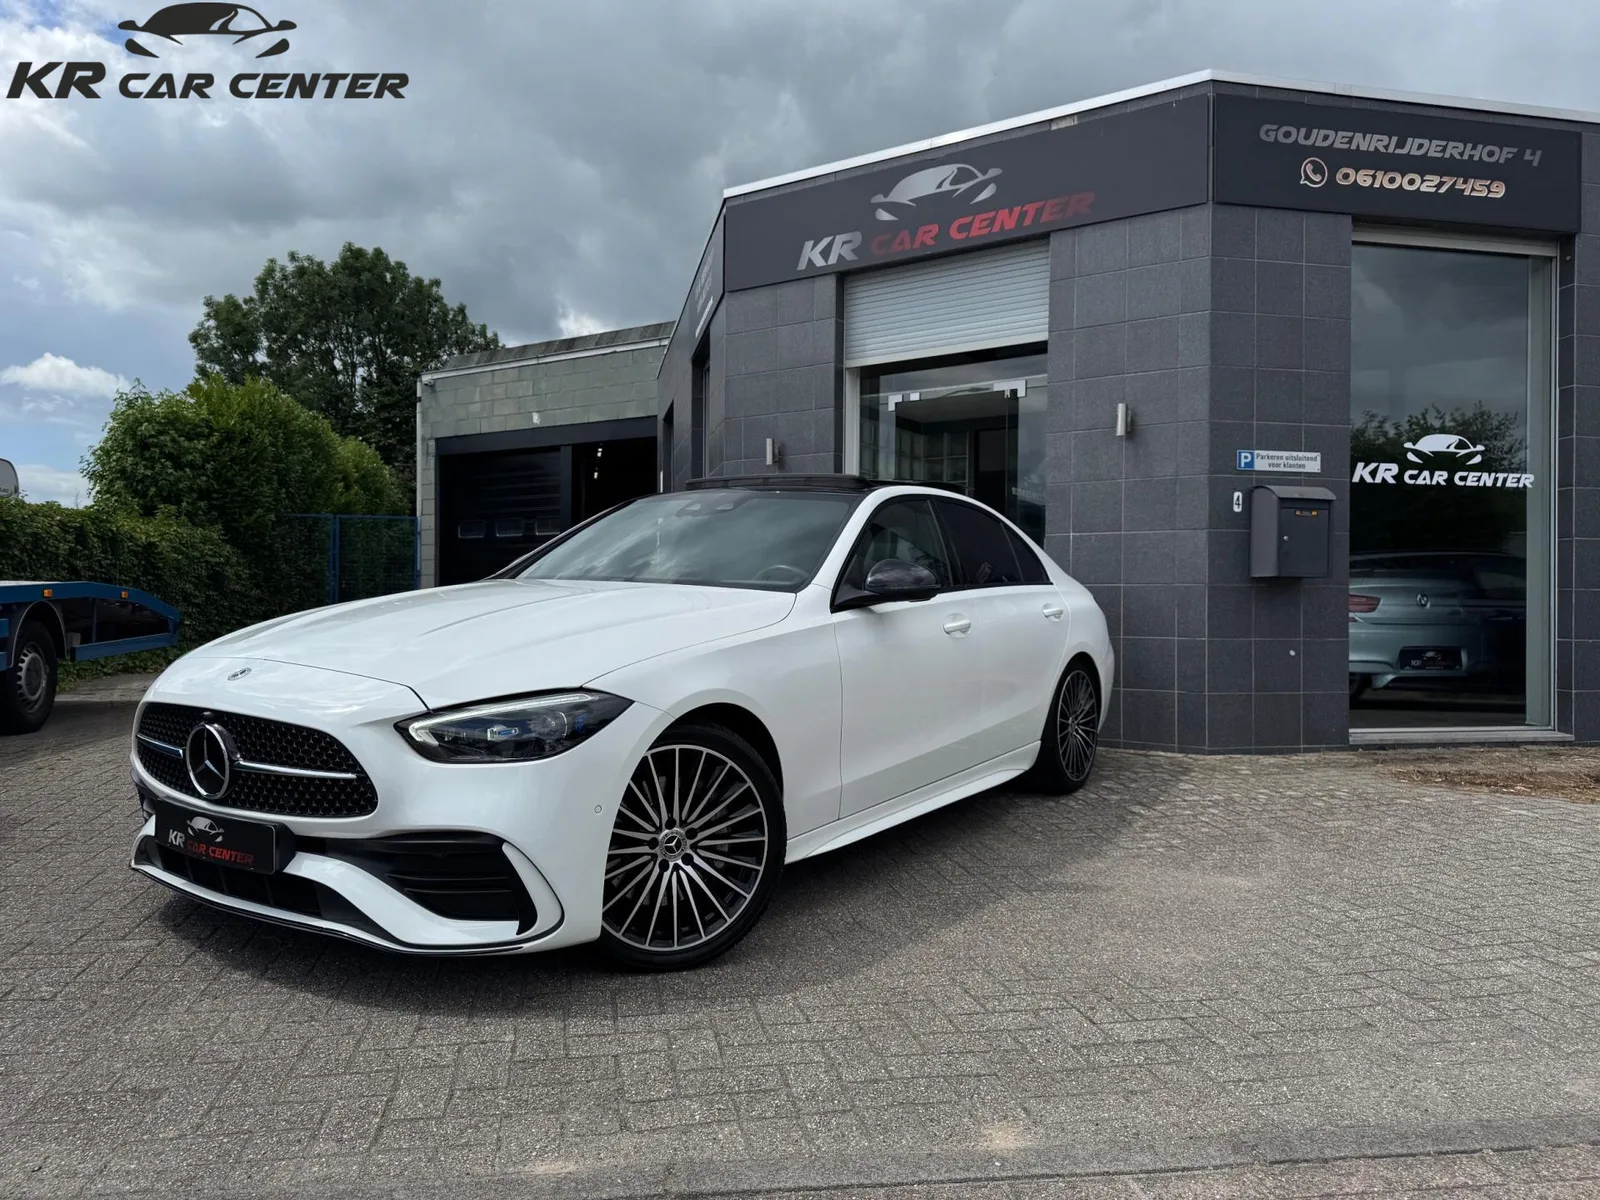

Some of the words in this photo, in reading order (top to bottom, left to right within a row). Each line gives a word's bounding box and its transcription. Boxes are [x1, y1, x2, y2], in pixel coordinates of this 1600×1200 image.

[1259, 123, 1518, 164] GOUDENRIJDERHOF
[1523, 149, 1543, 167] 4
[1335, 167, 1506, 198] 0610027459
[796, 231, 863, 271] KR
[870, 223, 939, 255] CAR
[949, 191, 1095, 240] CENTER
[1240, 452, 1252, 468] P
[1255, 452, 1284, 461] Parkeren
[1284, 453, 1318, 462] uitsluitend
[1283, 461, 1306, 469] klanten
[1351, 462, 1399, 484] KR
[1403, 469, 1448, 486] CAR
[1453, 471, 1535, 488] CENTER
[1234, 494, 1241, 509] 4
[168, 829, 185, 848] KR
[187, 840, 207, 854] CAR
[208, 846, 254, 865] CENTER
